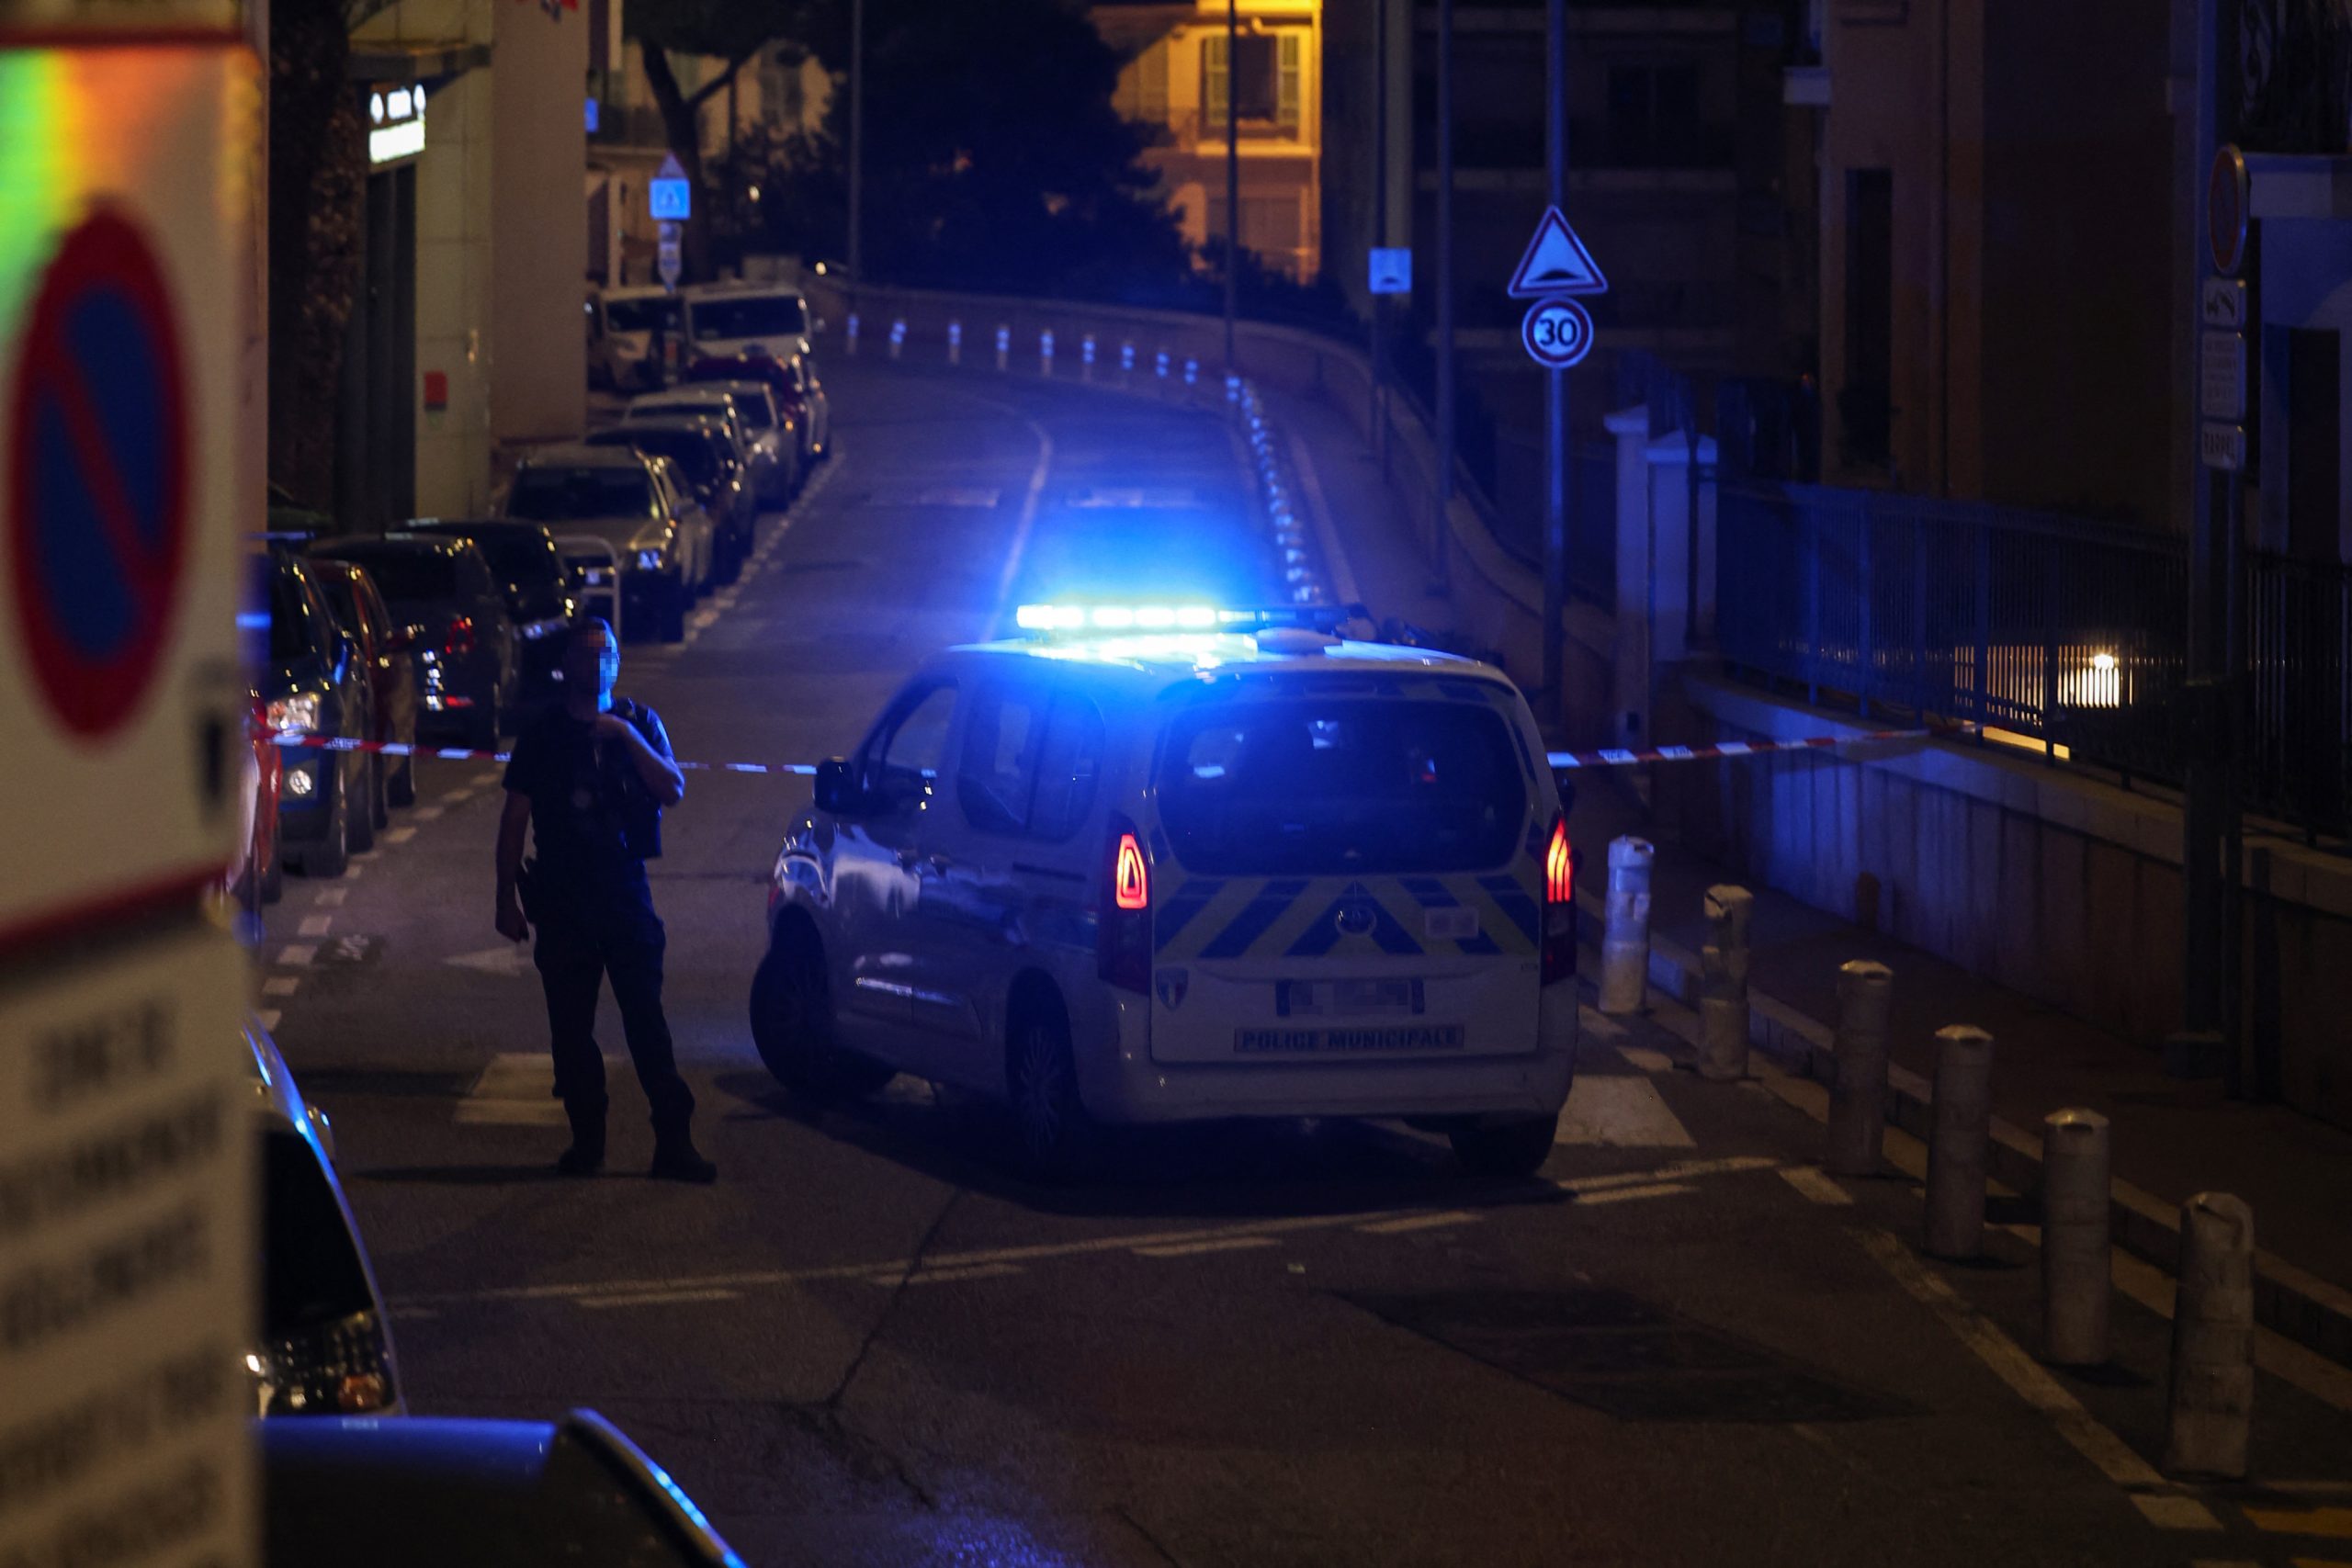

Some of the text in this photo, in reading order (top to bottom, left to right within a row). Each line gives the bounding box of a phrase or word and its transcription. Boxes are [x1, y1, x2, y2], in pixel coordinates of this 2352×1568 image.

[1539, 319, 1577, 346] 30
[1242, 1027, 1458, 1050] POLICE MUNICIPALE
